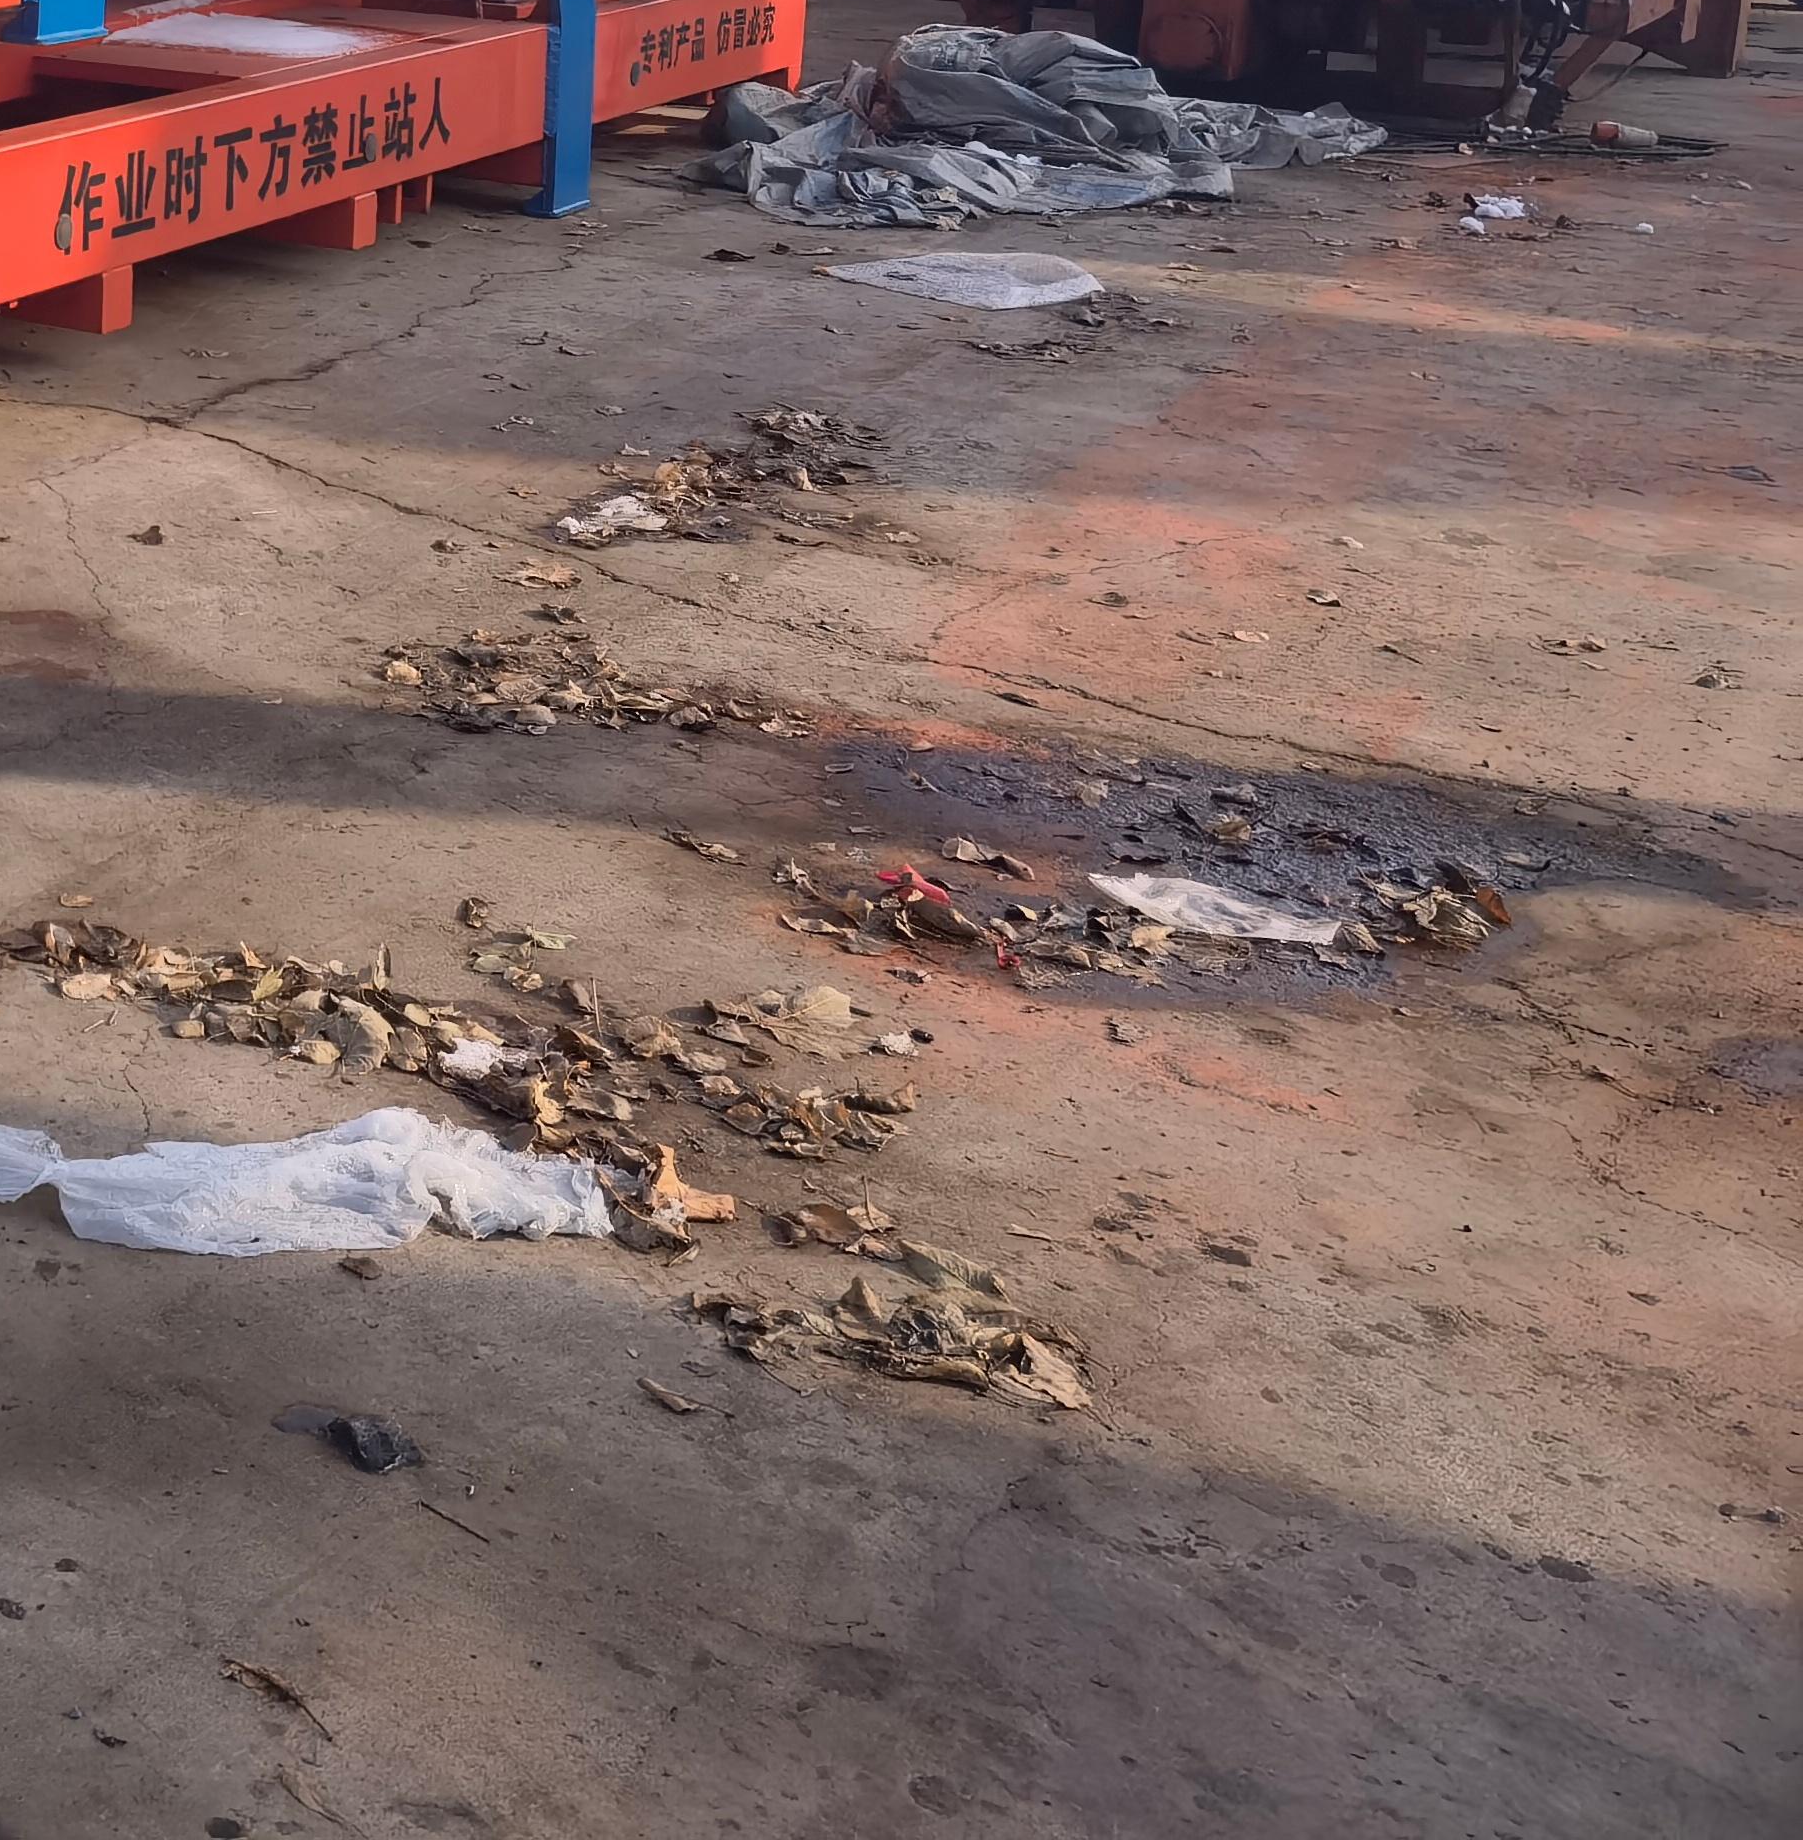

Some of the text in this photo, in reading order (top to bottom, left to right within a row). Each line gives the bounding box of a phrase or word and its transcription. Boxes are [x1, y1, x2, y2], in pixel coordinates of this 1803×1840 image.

[640, 2, 776, 74] 专利产品 仿冒必究
[53, 76, 451, 256] 作业时下方禁止站人
